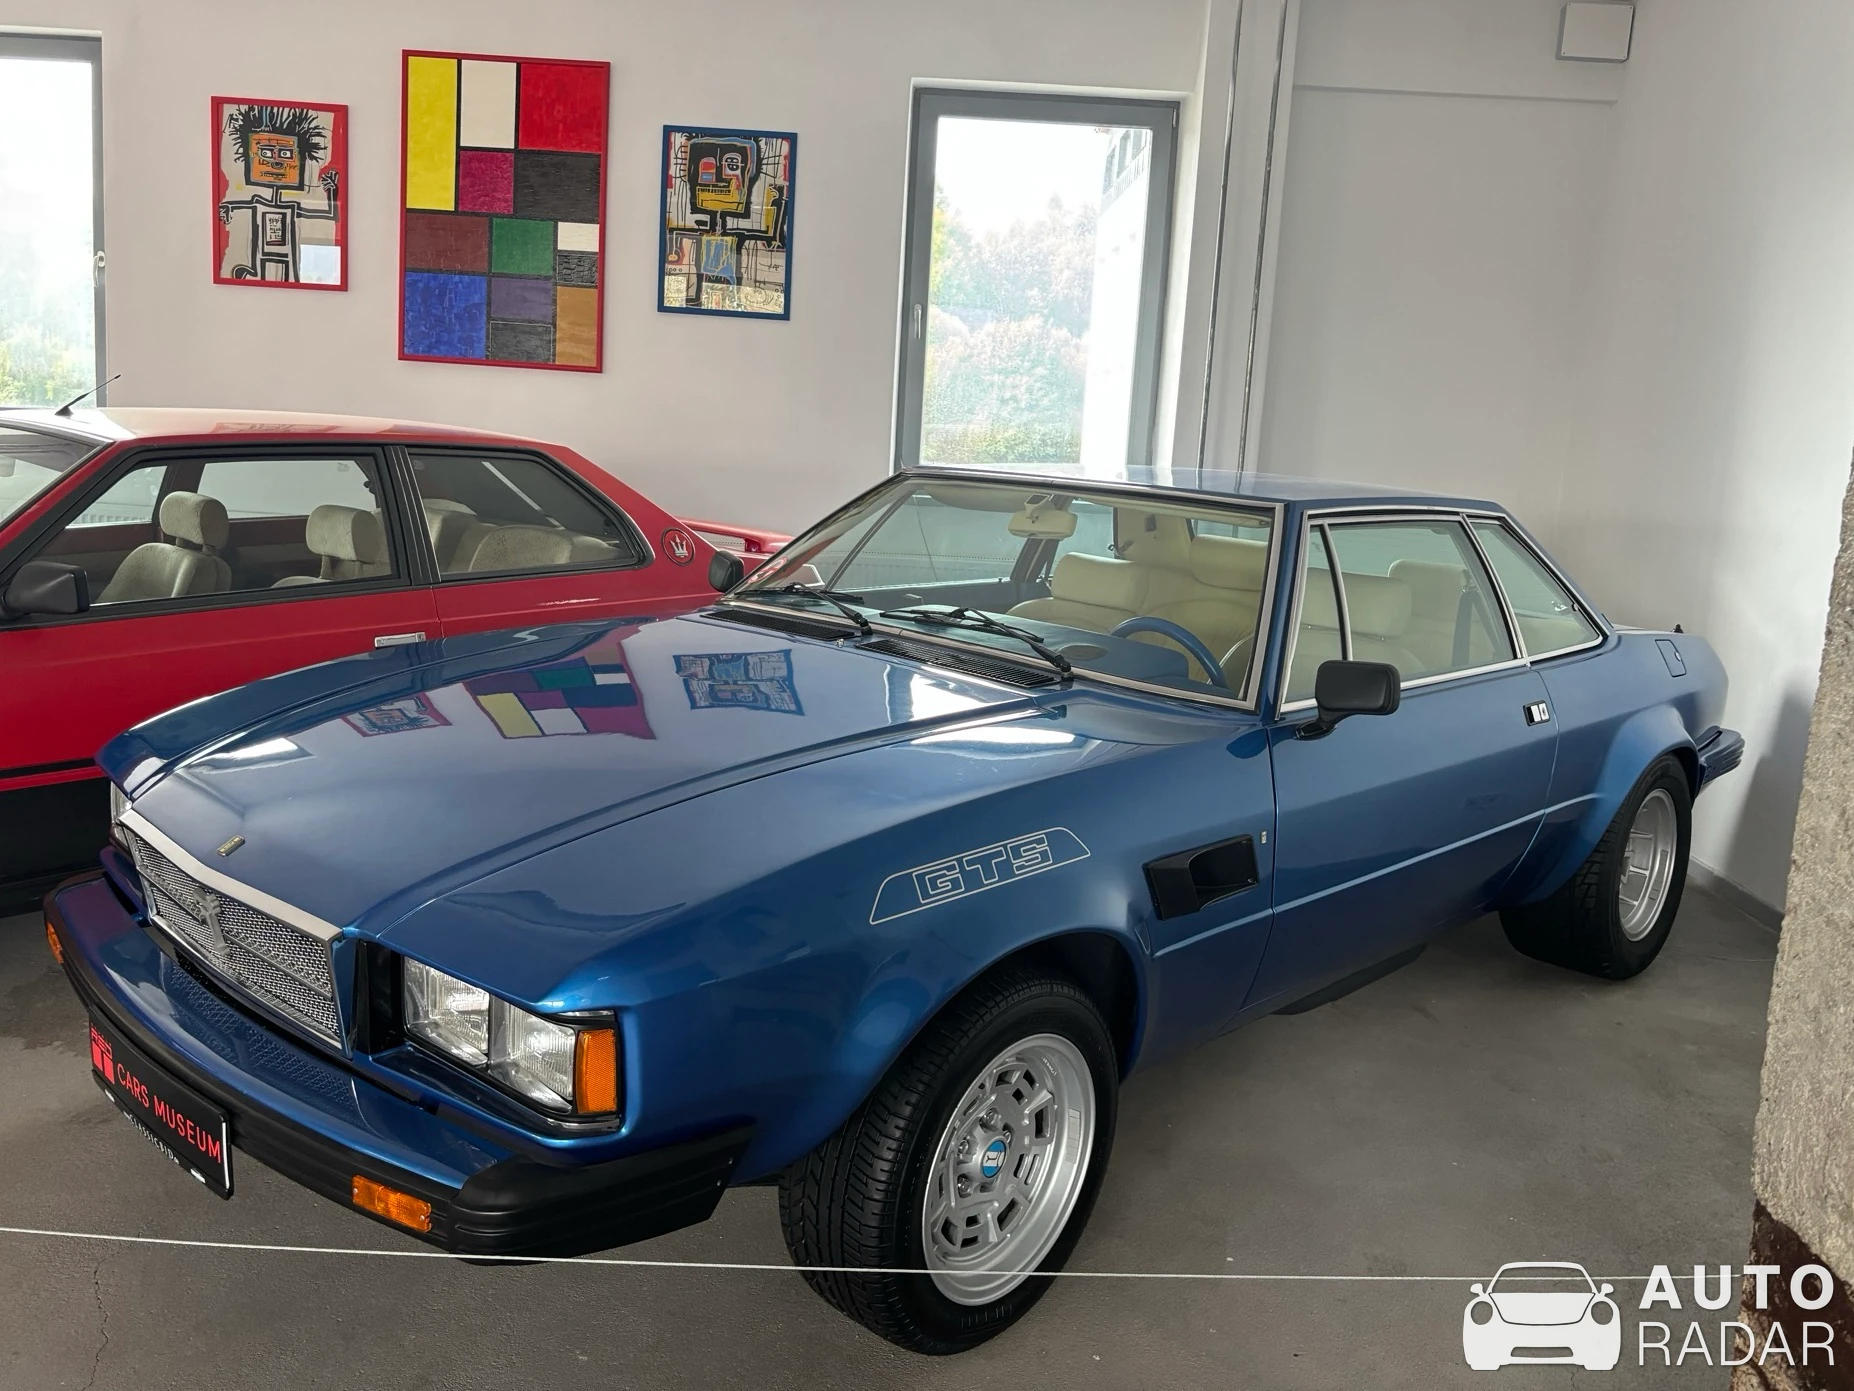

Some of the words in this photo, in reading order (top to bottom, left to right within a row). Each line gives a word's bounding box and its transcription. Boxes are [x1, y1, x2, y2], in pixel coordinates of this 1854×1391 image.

[912, 834, 1053, 903] GTS
[117, 1063, 150, 1108] CARS
[153, 1095, 221, 1163] MUSEUM
